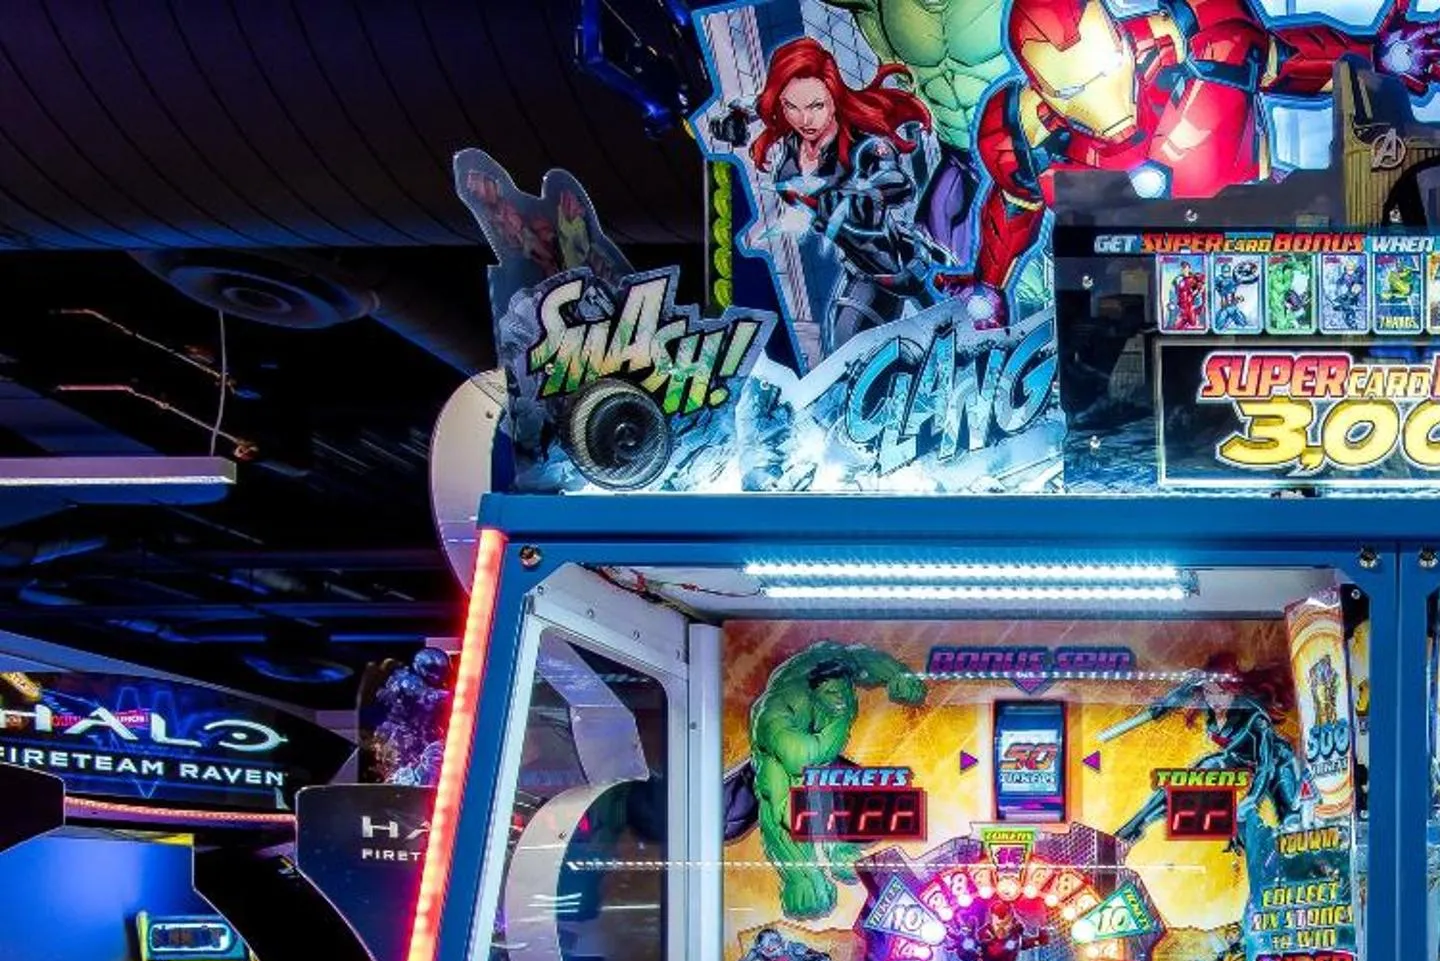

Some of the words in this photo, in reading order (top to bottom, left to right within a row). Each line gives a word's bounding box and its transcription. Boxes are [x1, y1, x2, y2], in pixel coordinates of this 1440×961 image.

[1095, 235, 1137, 252] GET
[1141, 232, 1224, 252] SUPER
[1224, 239, 1272, 252] CARD
[1273, 232, 1364, 252] BONUS
[1373, 236, 1433, 252] WHEN
[527, 277, 761, 415] SMASH!
[1200, 353, 1350, 398] SUPER
[1346, 366, 1432, 398] CARD
[929, 650, 1051, 673] BONUS
[1054, 650, 1134, 673] SPIN
[0, 704, 290, 751] HALO
[0, 746, 164, 776] IRETEAM
[180, 763, 284, 786] RAVEN
[805, 768, 911, 786] TICKETS
[1157, 769, 1249, 787] TOKENS
[362, 816, 431, 839] HA
[362, 848, 421, 861] FIRET
[1263, 882, 1340, 908] COLLECT
